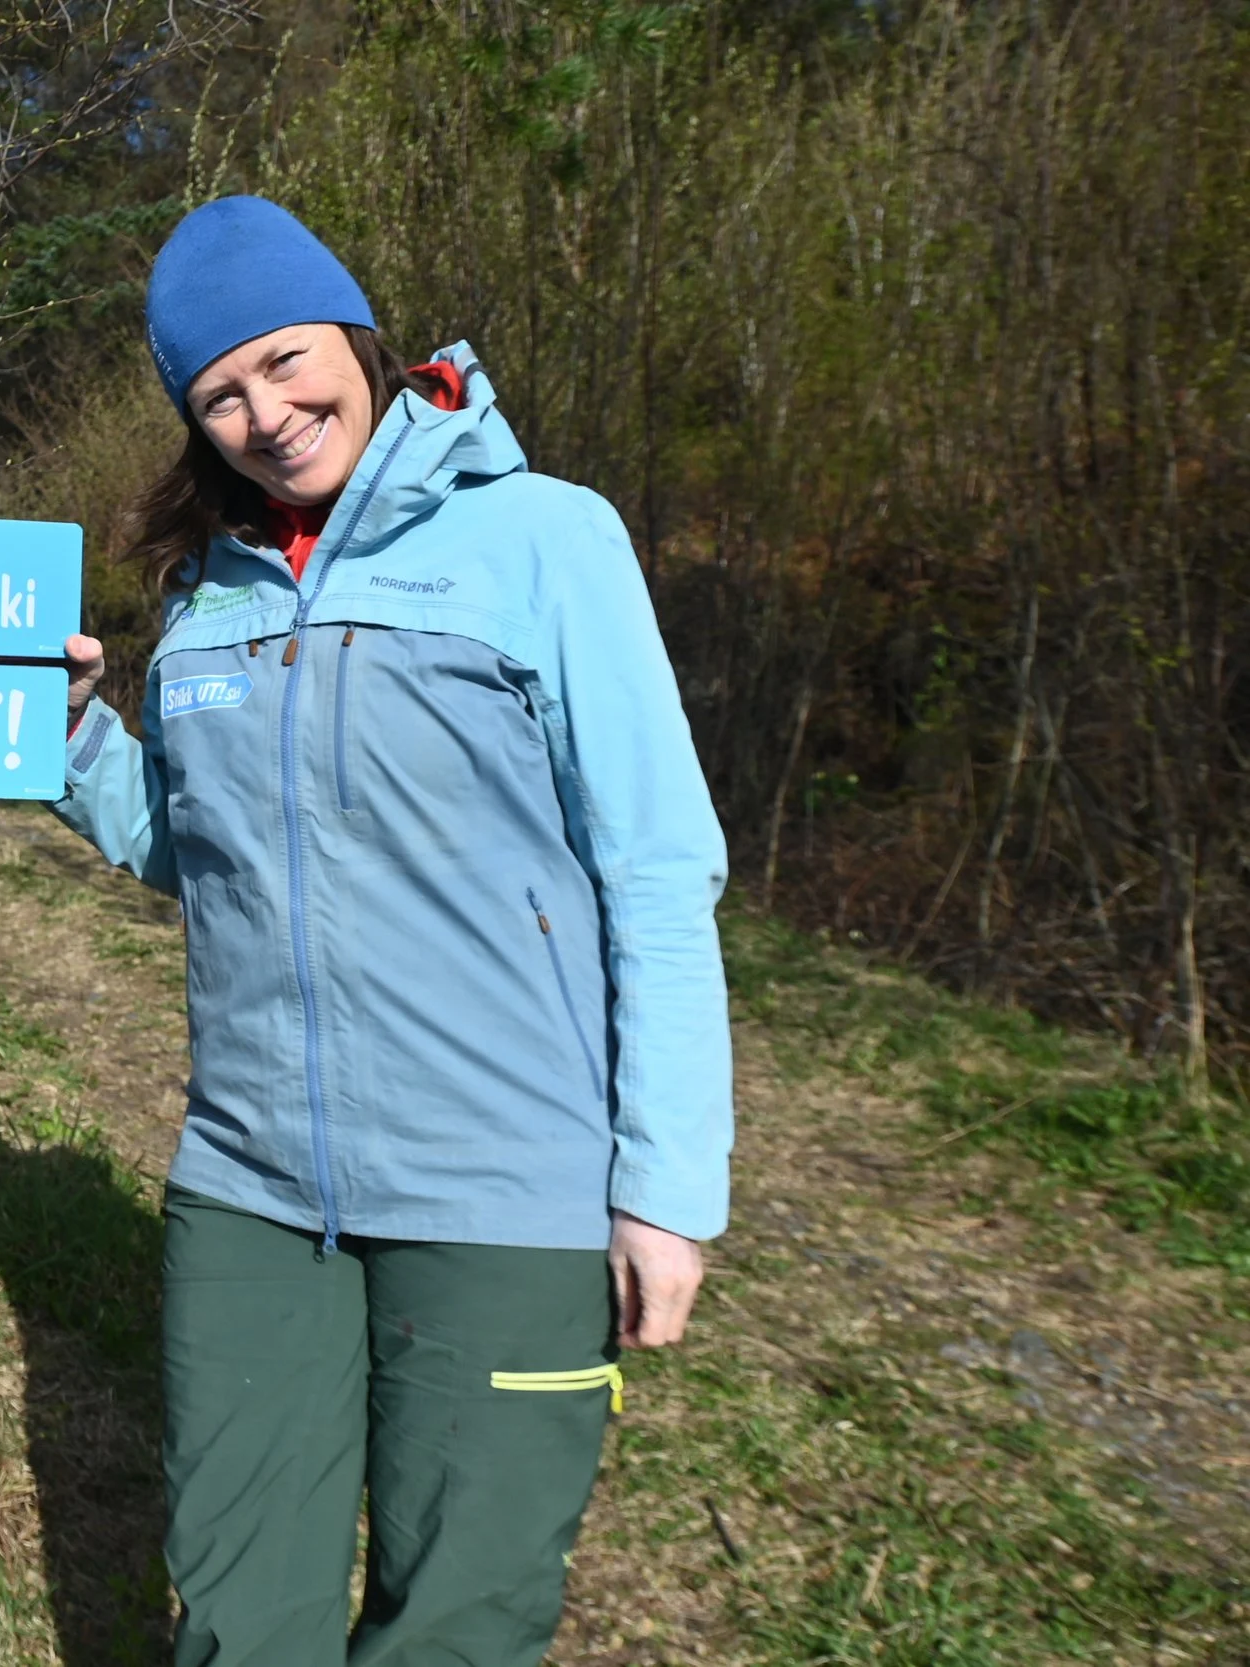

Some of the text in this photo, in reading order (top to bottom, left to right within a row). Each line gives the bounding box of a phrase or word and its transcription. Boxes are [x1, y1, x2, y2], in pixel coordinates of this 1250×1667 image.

[369, 575, 435, 594] NORRØNA
[166, 685, 193, 711] Stikk
[197, 681, 228, 703] UT!
